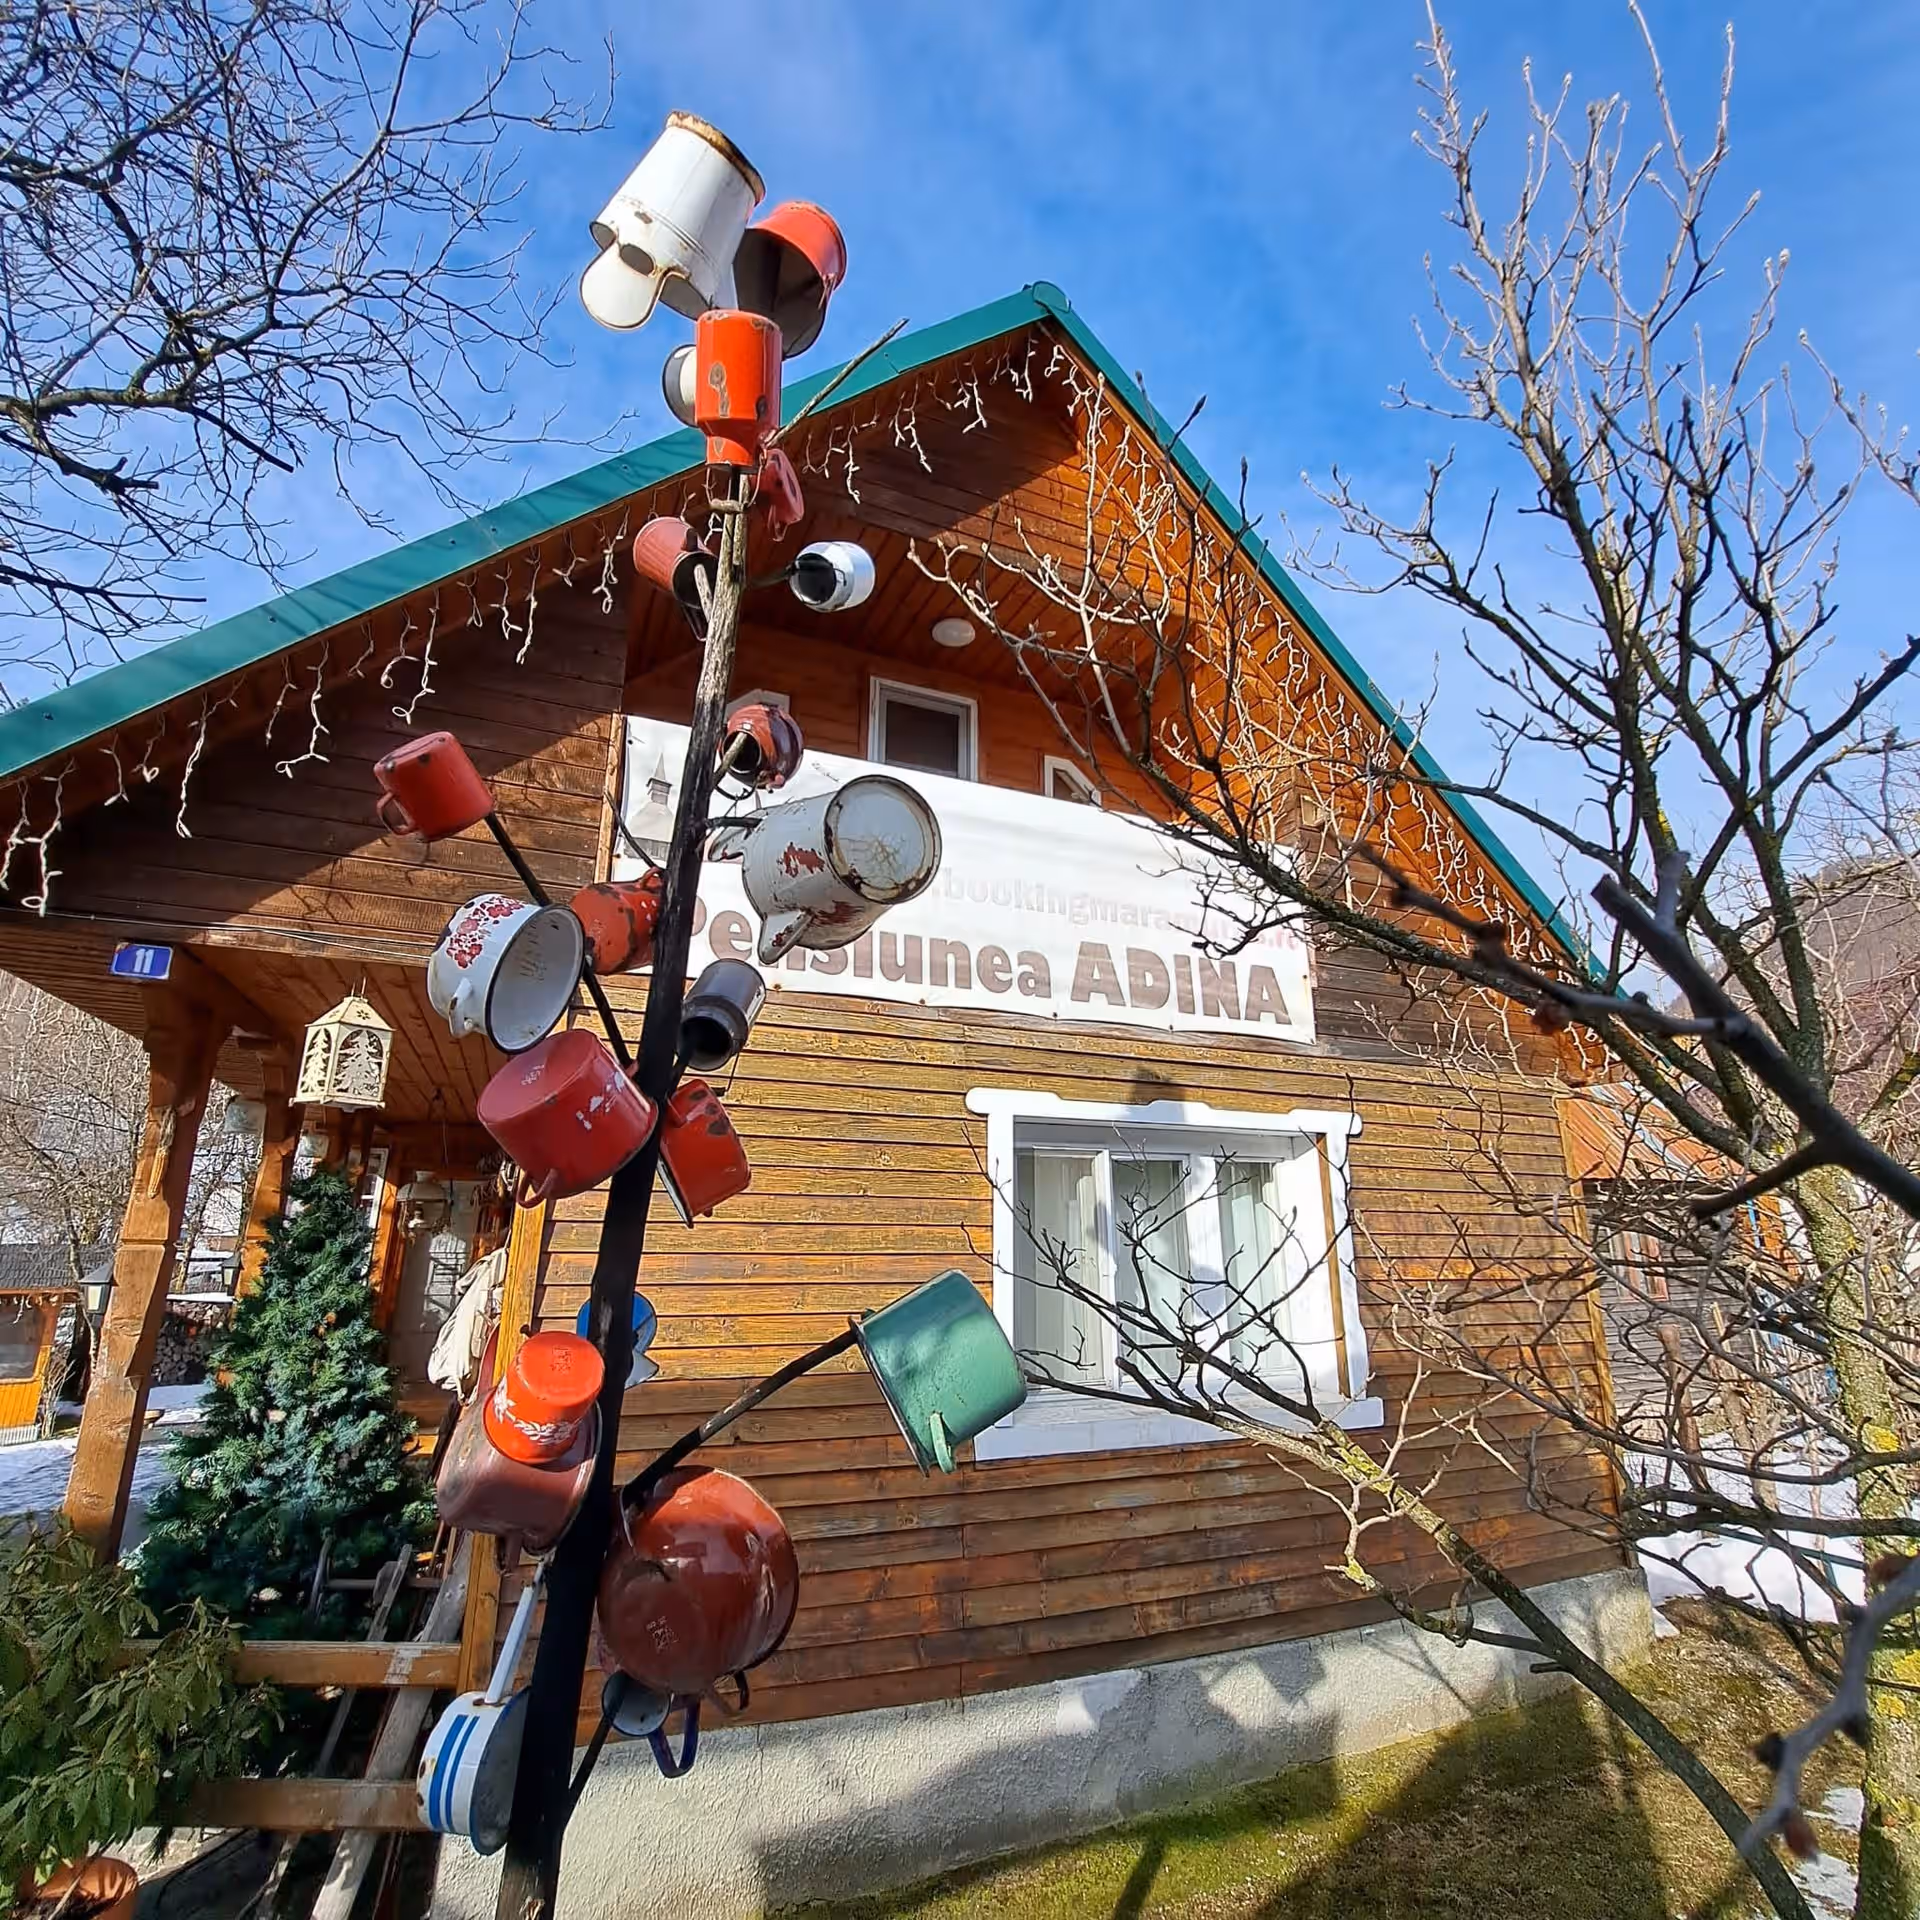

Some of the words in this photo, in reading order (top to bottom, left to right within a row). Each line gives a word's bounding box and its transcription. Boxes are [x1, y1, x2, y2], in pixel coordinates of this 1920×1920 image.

[134, 948, 155, 974] 11
[691, 896, 1051, 998] esiunea
[1071, 941, 1292, 1025] ADINA
